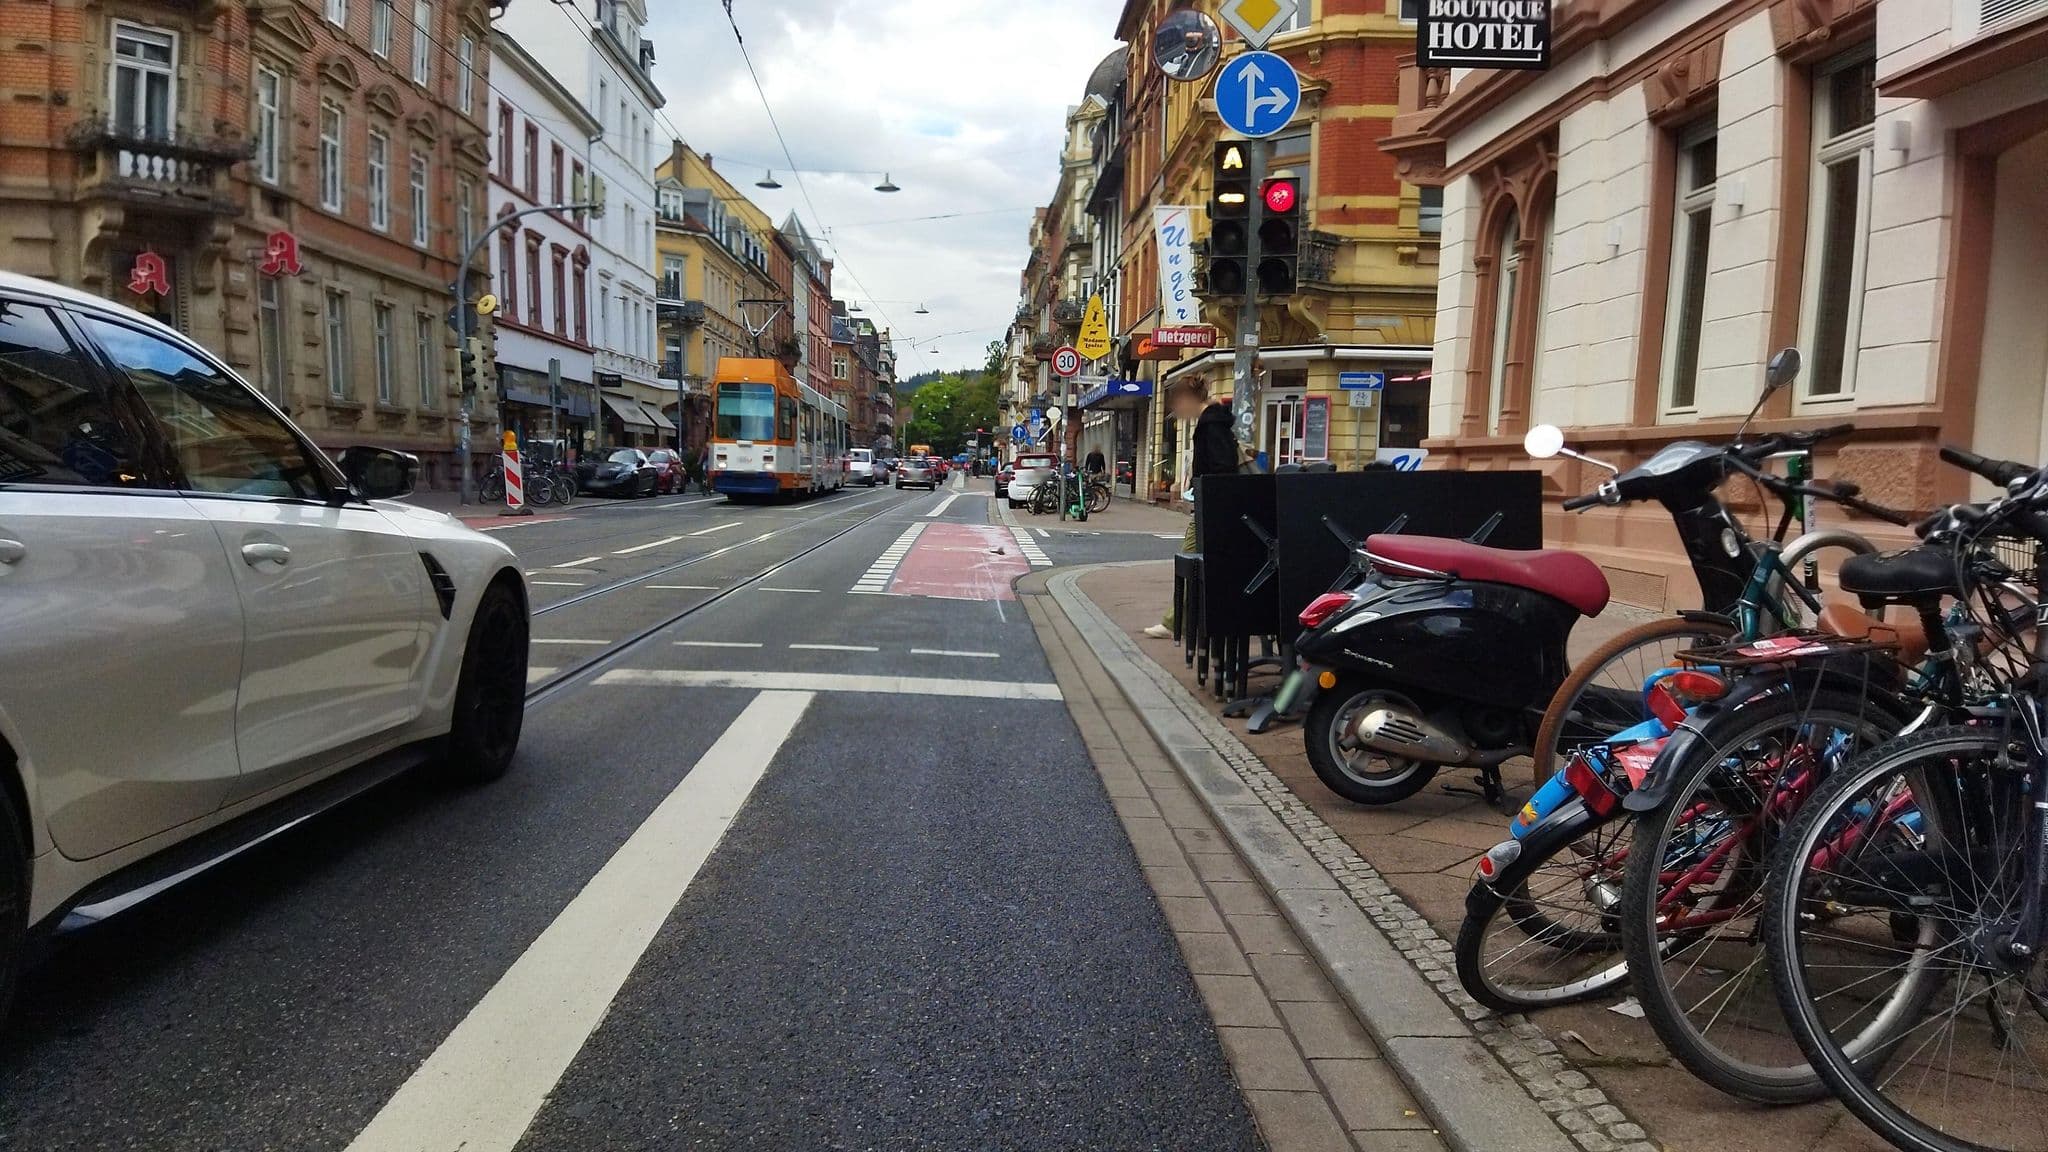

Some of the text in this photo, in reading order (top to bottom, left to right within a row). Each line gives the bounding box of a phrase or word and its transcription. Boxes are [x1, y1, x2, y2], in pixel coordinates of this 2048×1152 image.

[1428, 0, 1544, 23] BOUTIQUE
[1427, 22, 1543, 50] HOTEL
[1162, 225, 1188, 320] Unger
[1157, 330, 1212, 345] Metzgerei
[1058, 355, 1075, 368] 30
